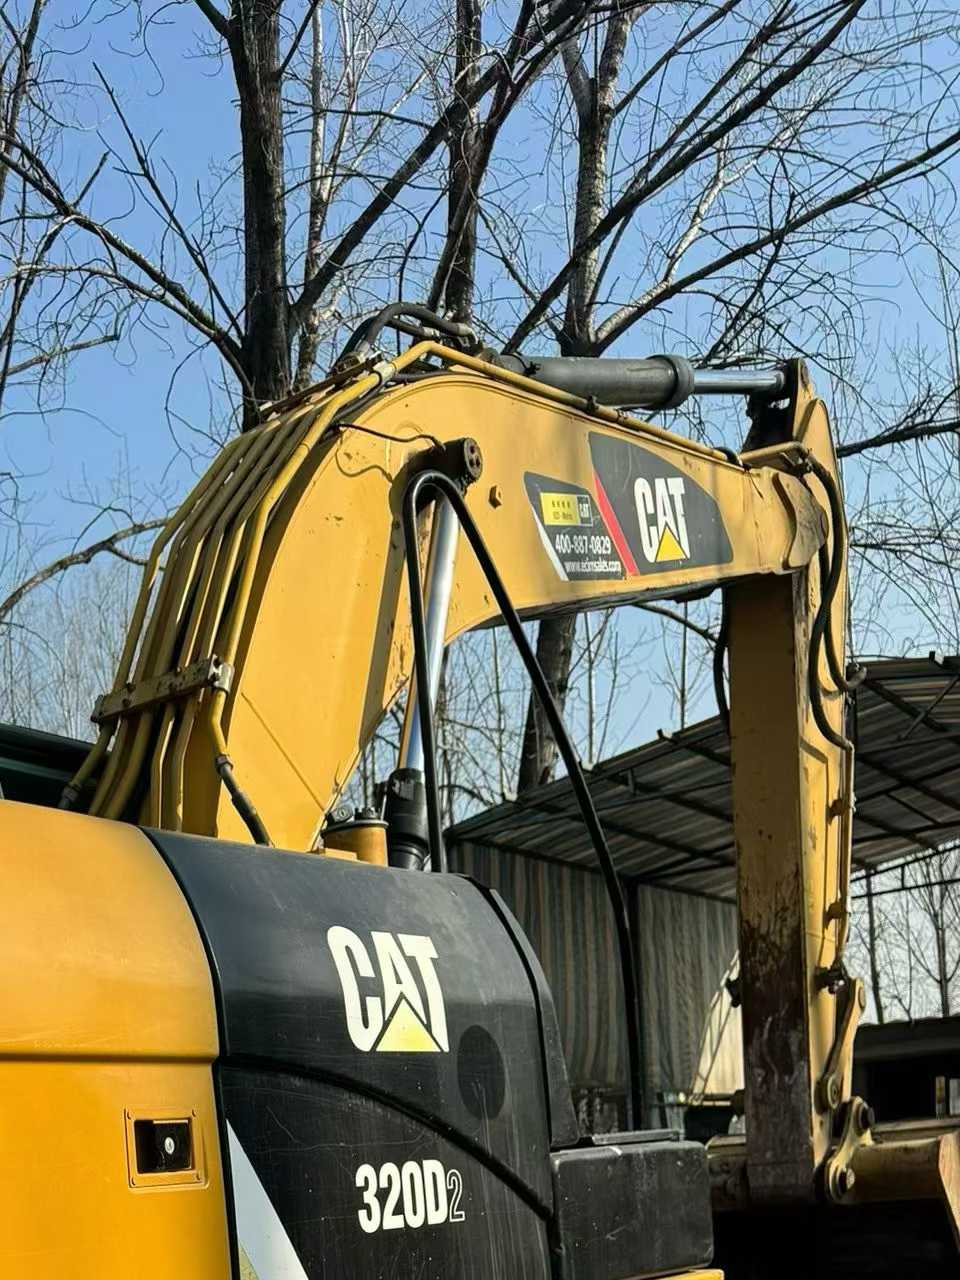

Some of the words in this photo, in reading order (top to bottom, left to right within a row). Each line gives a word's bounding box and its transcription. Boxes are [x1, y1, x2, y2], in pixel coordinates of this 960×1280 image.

[555, 534, 611, 554] 400-887-0829
[634, 477, 690, 563] CAT
[327, 926, 449, 1052] CAT
[355, 1159, 465, 1233] 320D2
